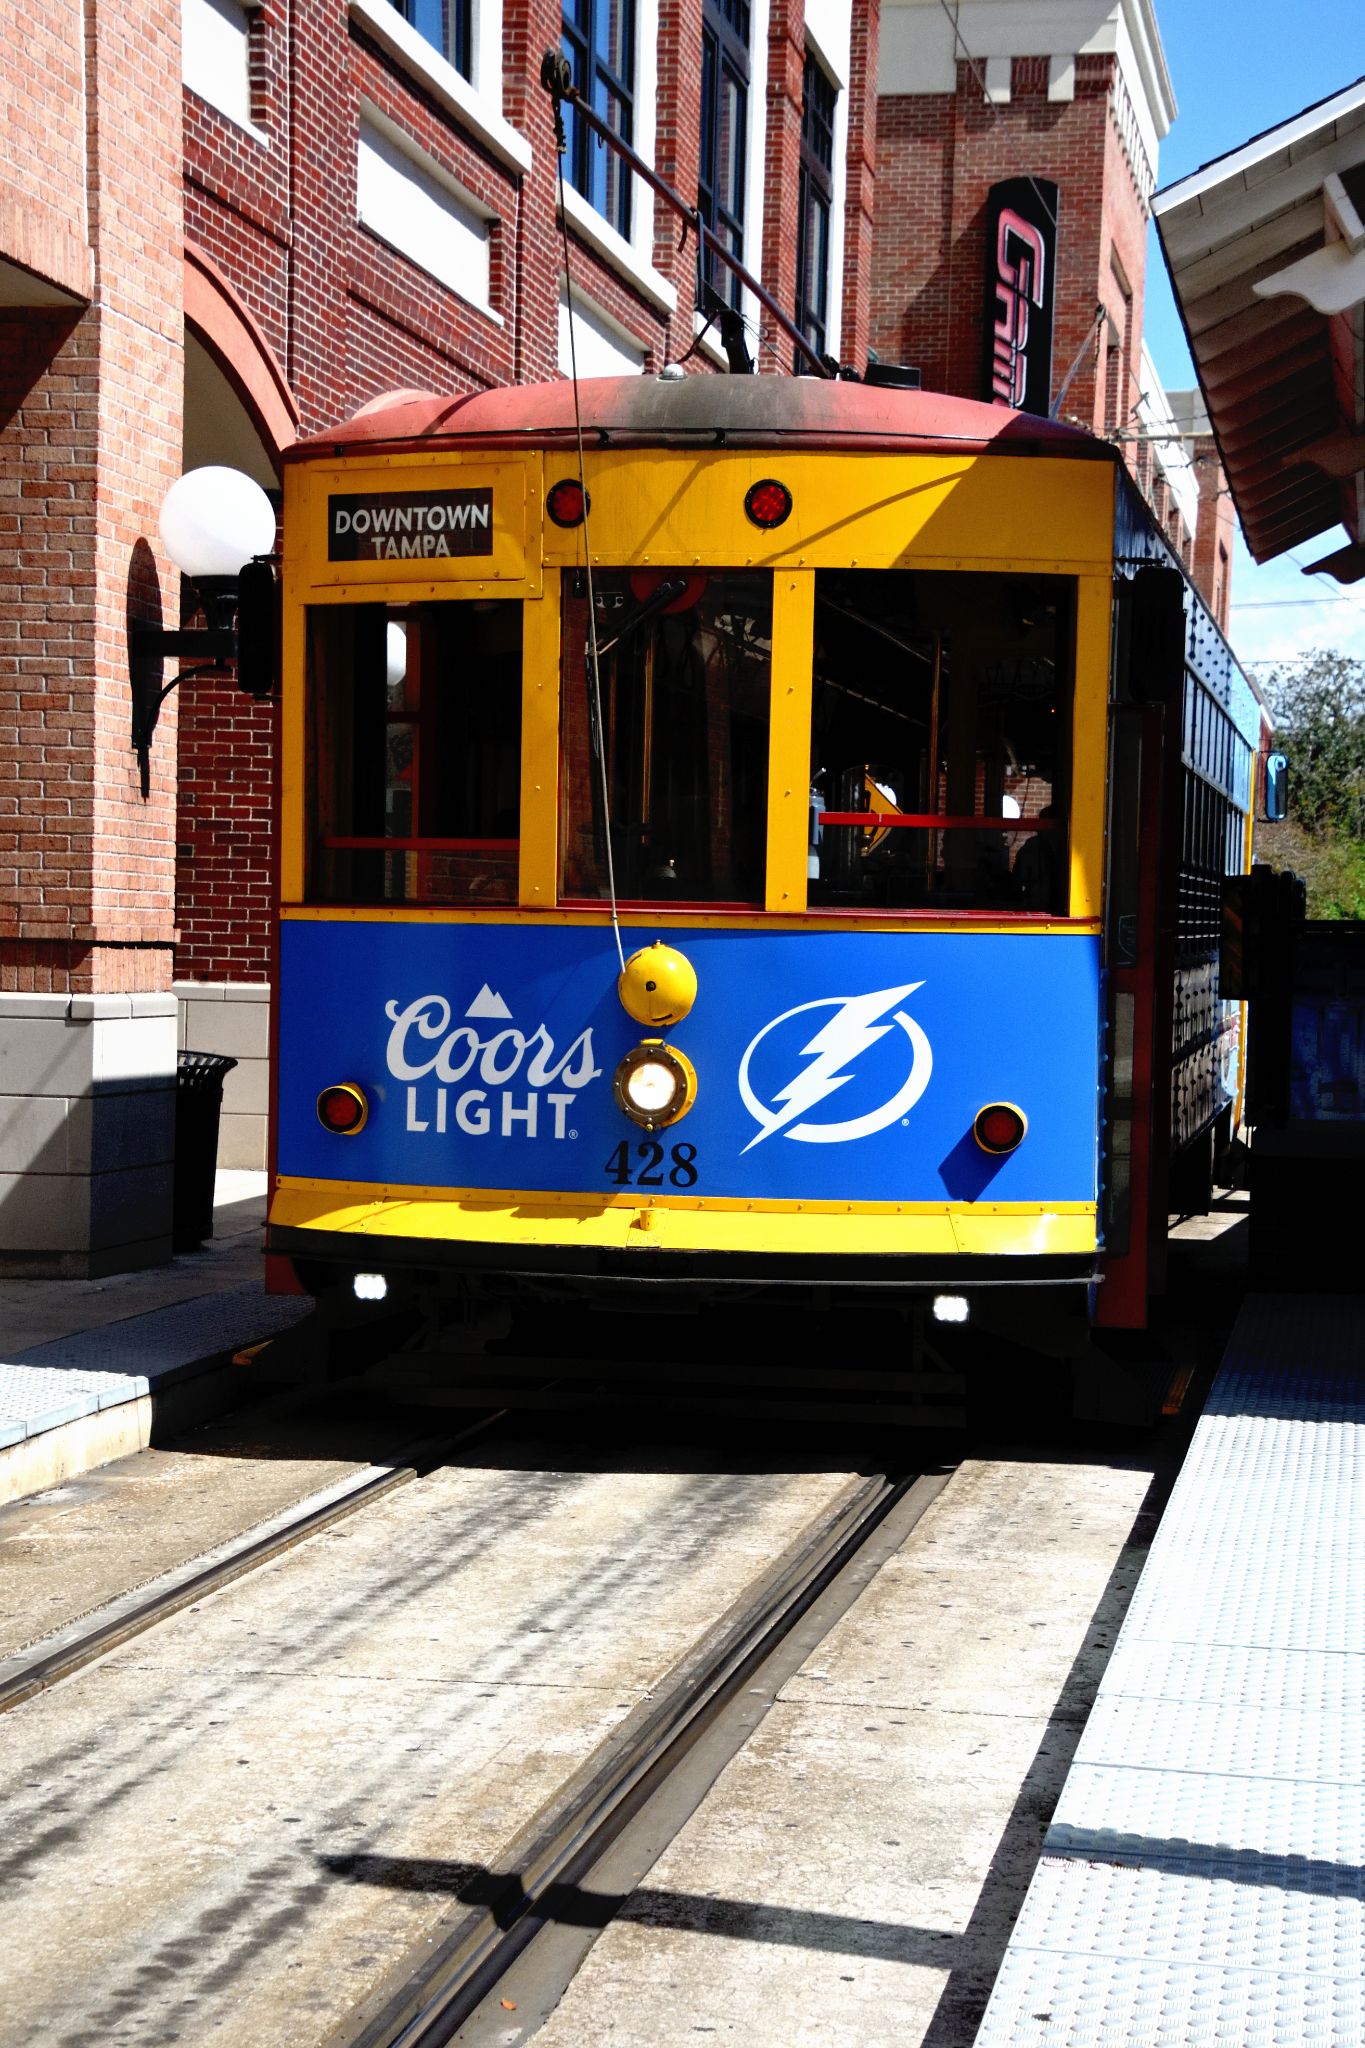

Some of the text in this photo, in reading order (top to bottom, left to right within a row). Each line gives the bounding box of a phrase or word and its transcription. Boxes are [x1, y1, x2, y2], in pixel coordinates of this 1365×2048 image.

[993, 208, 1045, 410] GAM
[335, 504, 489, 534] DOWNTOWN
[371, 534, 451, 560] TAMPA
[385, 994, 603, 1089] Coors
[406, 1086, 577, 1139] LIGHT
[604, 1140, 698, 1188] 428
